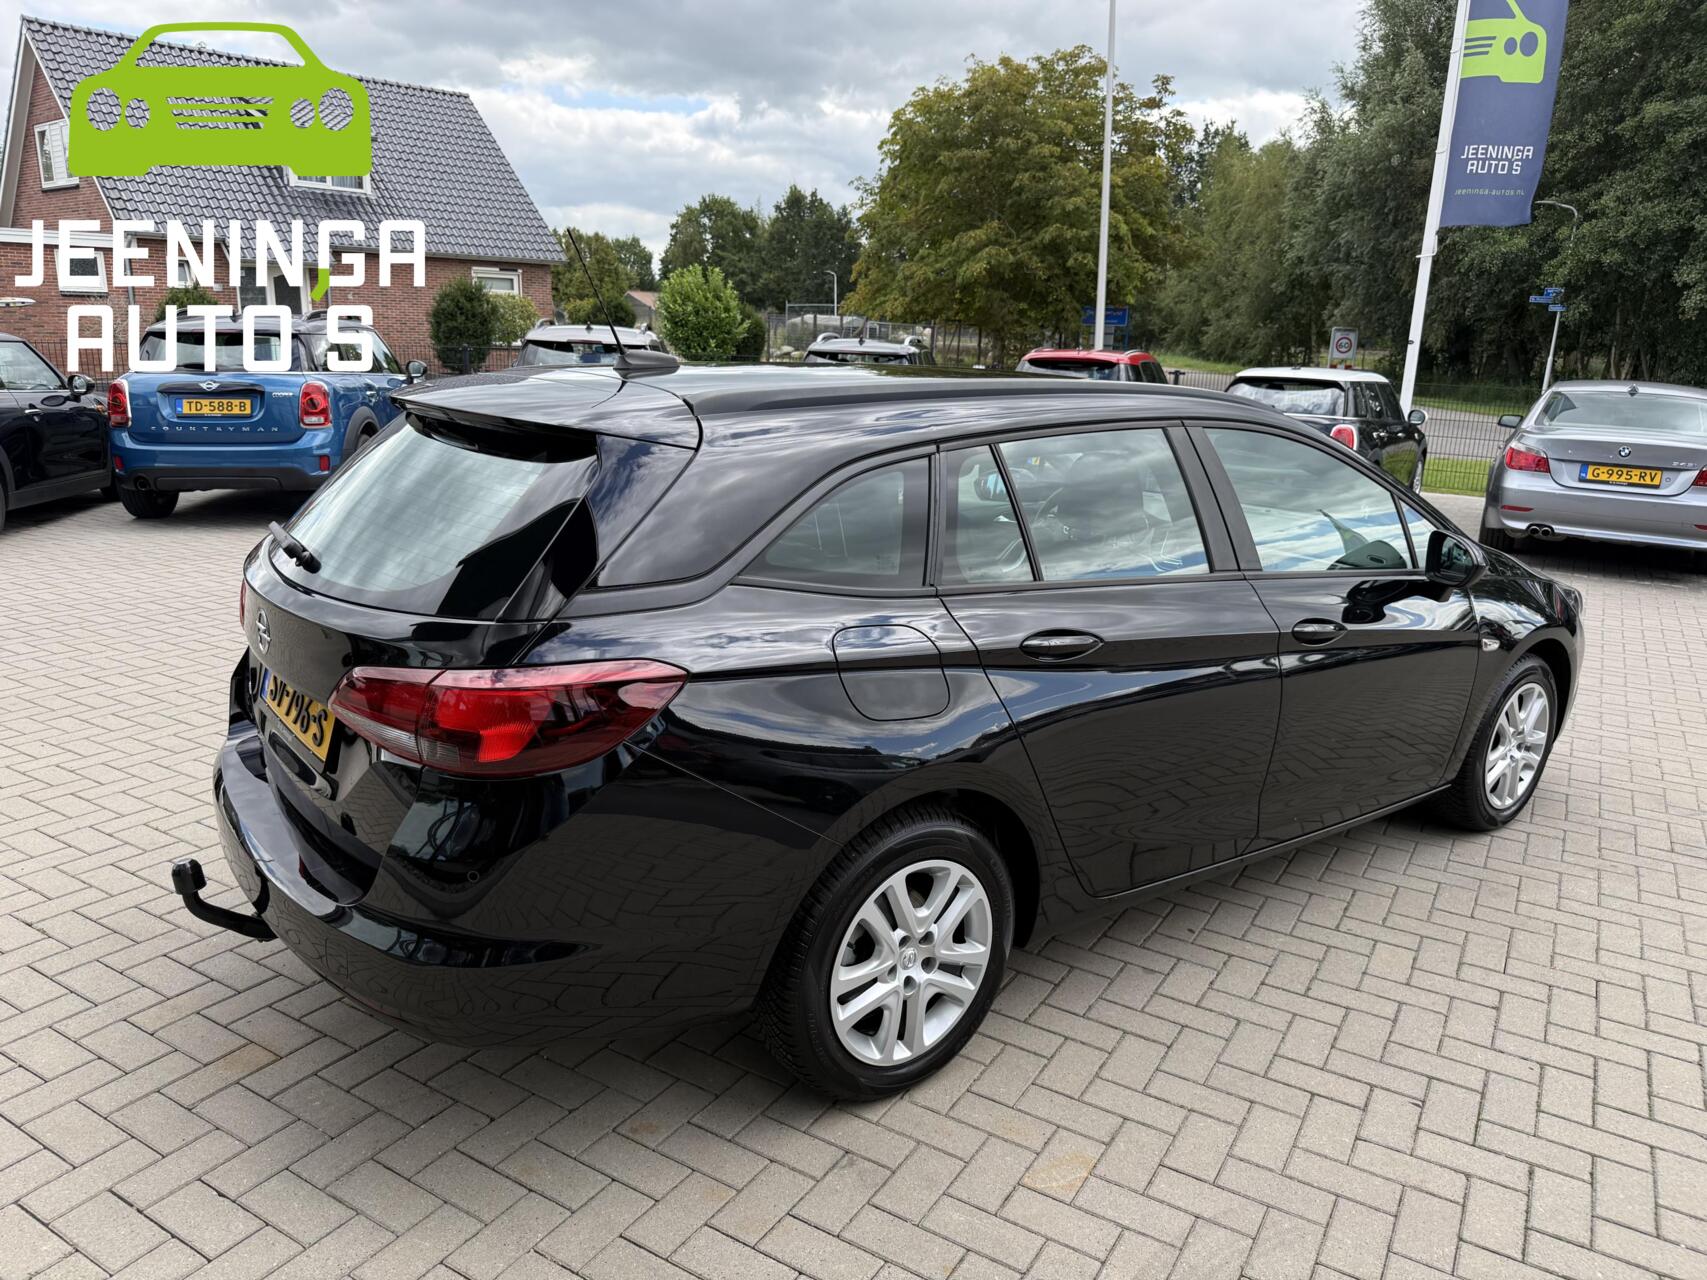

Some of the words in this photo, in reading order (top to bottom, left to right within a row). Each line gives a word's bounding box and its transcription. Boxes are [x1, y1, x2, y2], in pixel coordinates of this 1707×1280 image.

[1460, 144, 1534, 160] JEENINGA
[1338, 341, 1349, 349] 60
[186, 400, 247, 412] TD-588-B
[1591, 467, 1658, 483] G-995-RV
